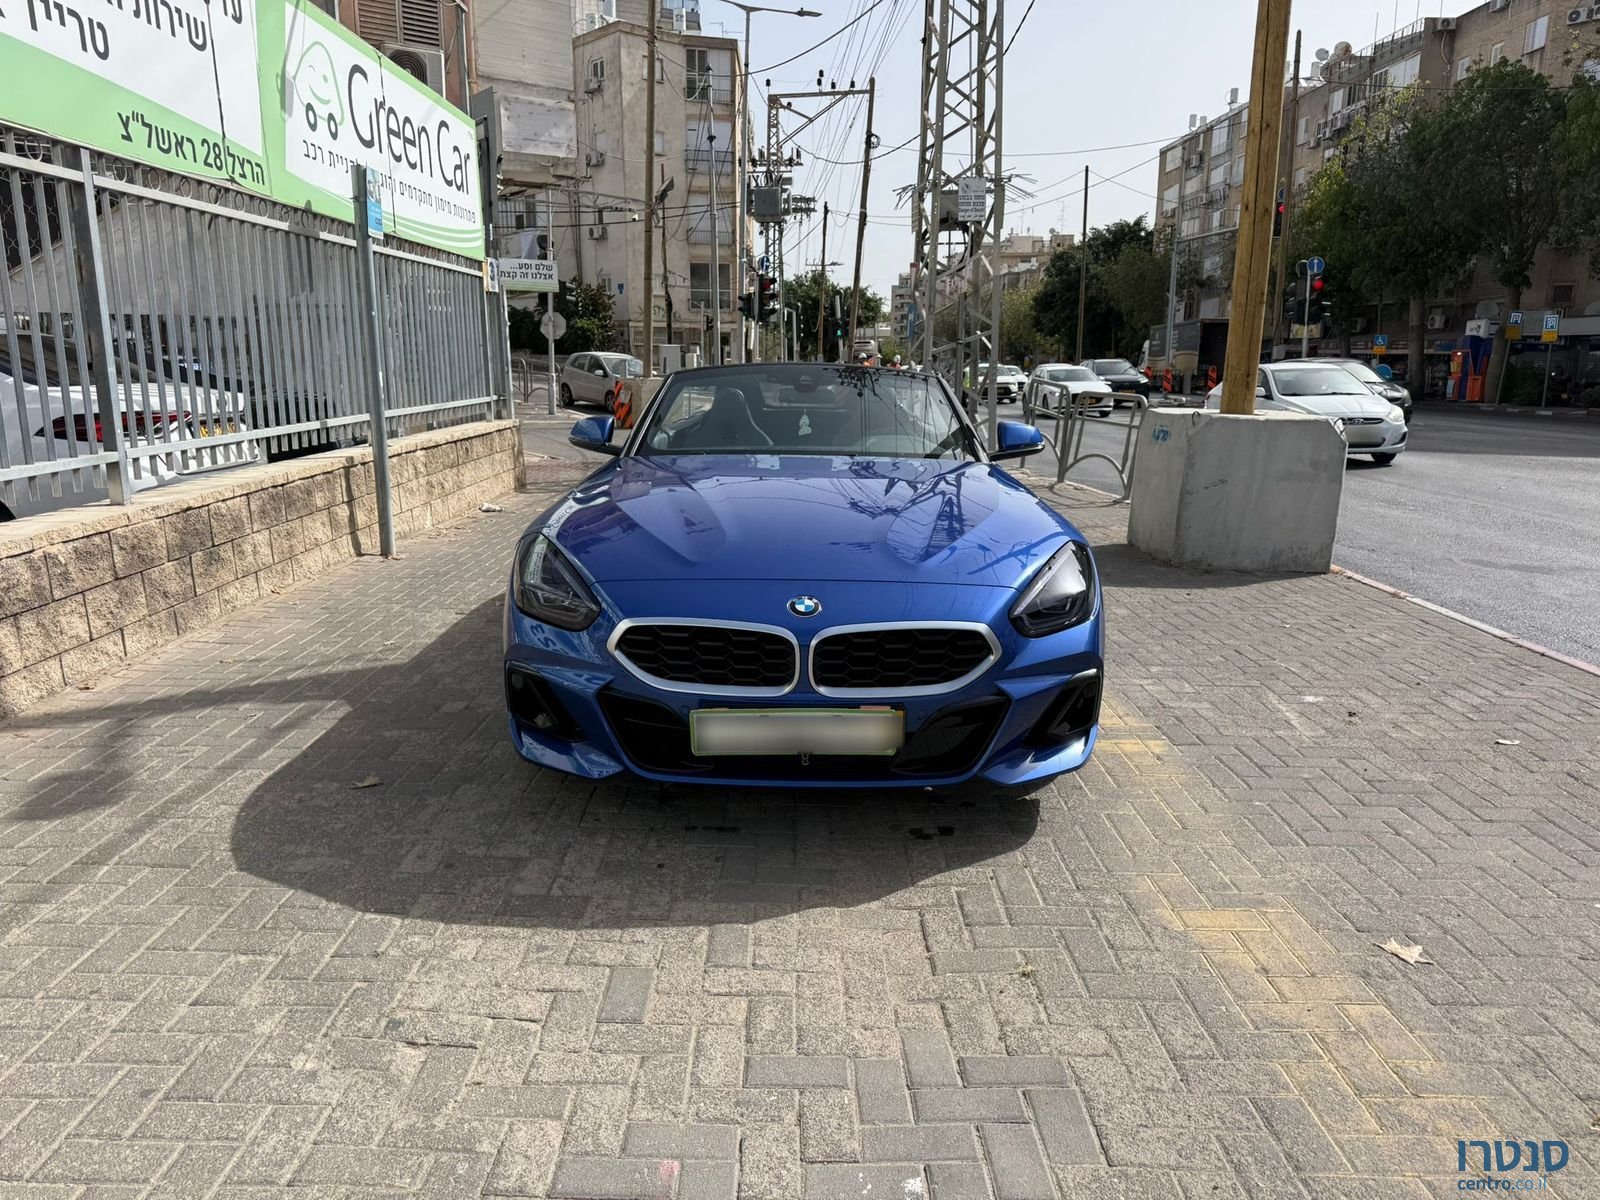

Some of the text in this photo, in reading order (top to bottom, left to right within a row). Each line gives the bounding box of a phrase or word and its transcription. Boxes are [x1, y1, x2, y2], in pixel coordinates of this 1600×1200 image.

[347, 64, 471, 195] Green Car
[201, 138, 223, 171] 28
[227, 145, 265, 185] הרצל
[302, 139, 324, 165] רכב
[500, 270, 554, 280] אצלנו זה קצת
[535, 263, 553, 271] שלם
